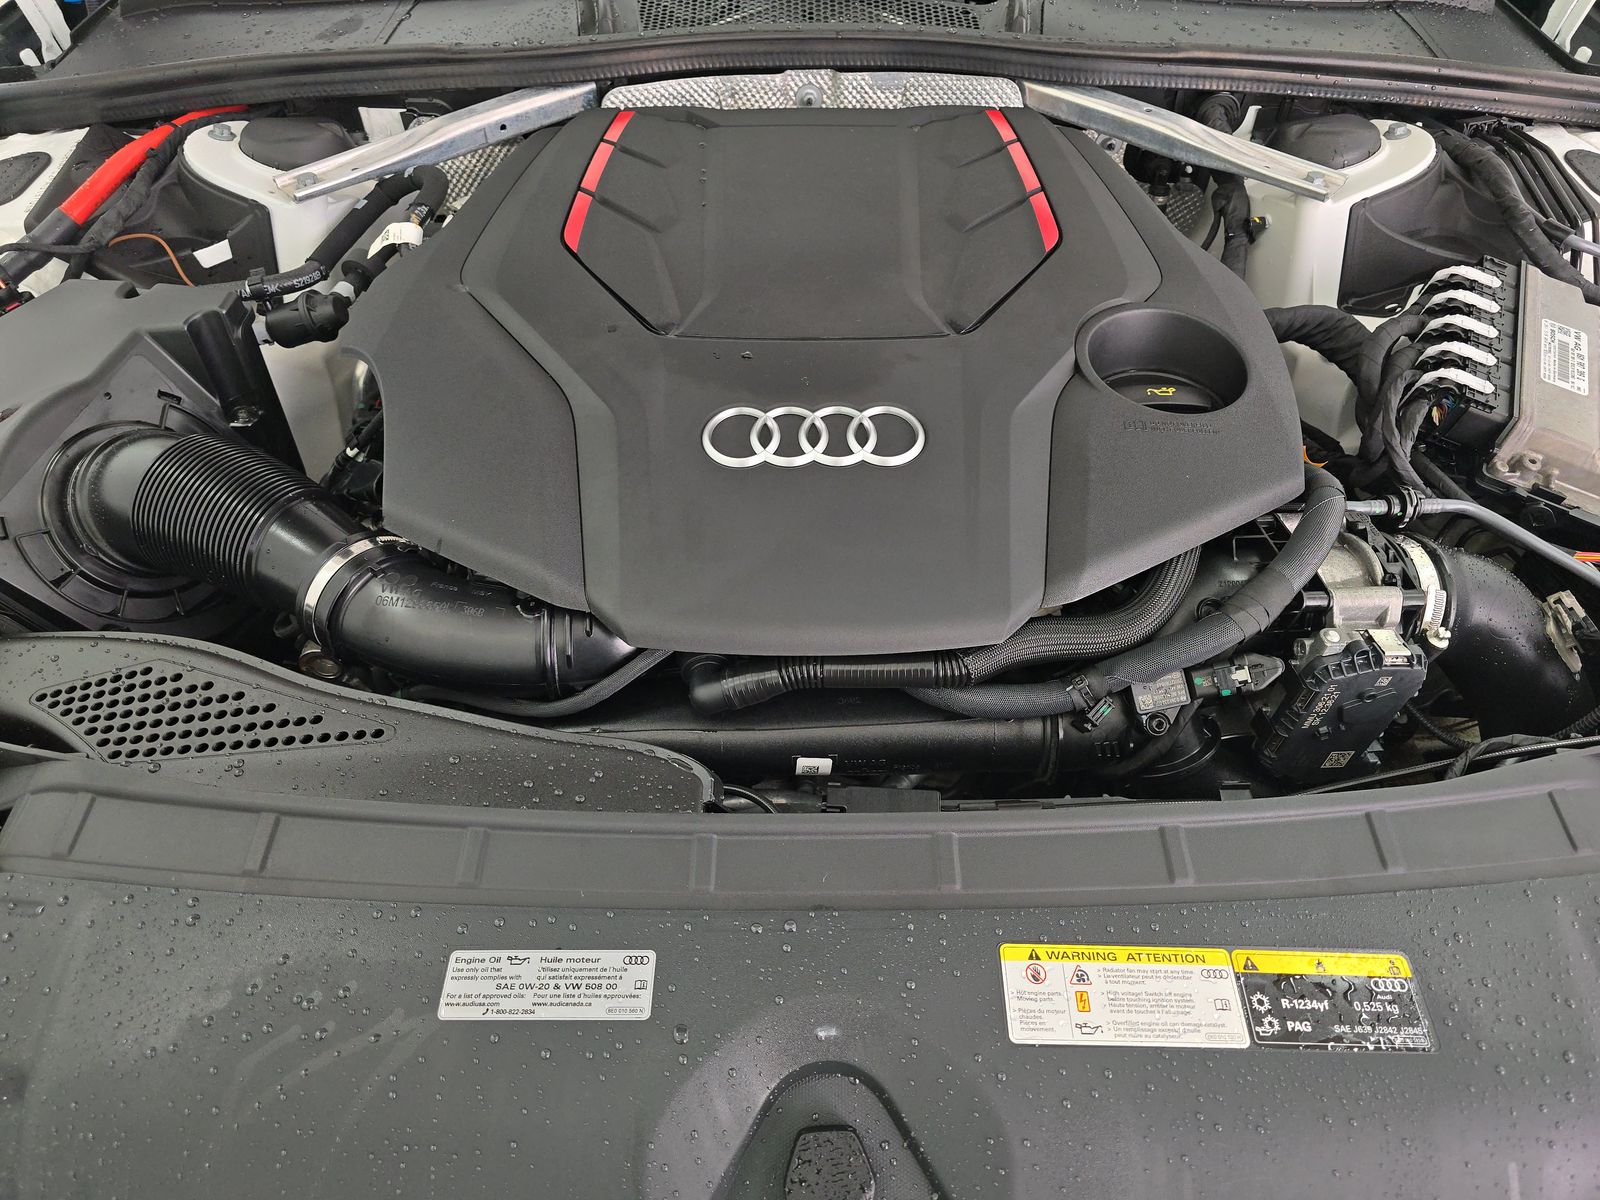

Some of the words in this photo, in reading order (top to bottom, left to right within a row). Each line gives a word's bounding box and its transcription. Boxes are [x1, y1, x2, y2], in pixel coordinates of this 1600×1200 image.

[454, 956, 486, 965] Engine
[488, 956, 502, 964] Oil
[540, 956, 564, 964] Huile
[1045, 950, 1117, 961] WARNING
[1126, 952, 1206, 963] ATTENTION
[1281, 999, 1329, 1013] R-1234yf
[1353, 1001, 1383, 1012] 0,525
[1385, 1001, 1399, 1014] kg
[1286, 1021, 1312, 1032] PAG
[1334, 1024, 1352, 1033] SAE
